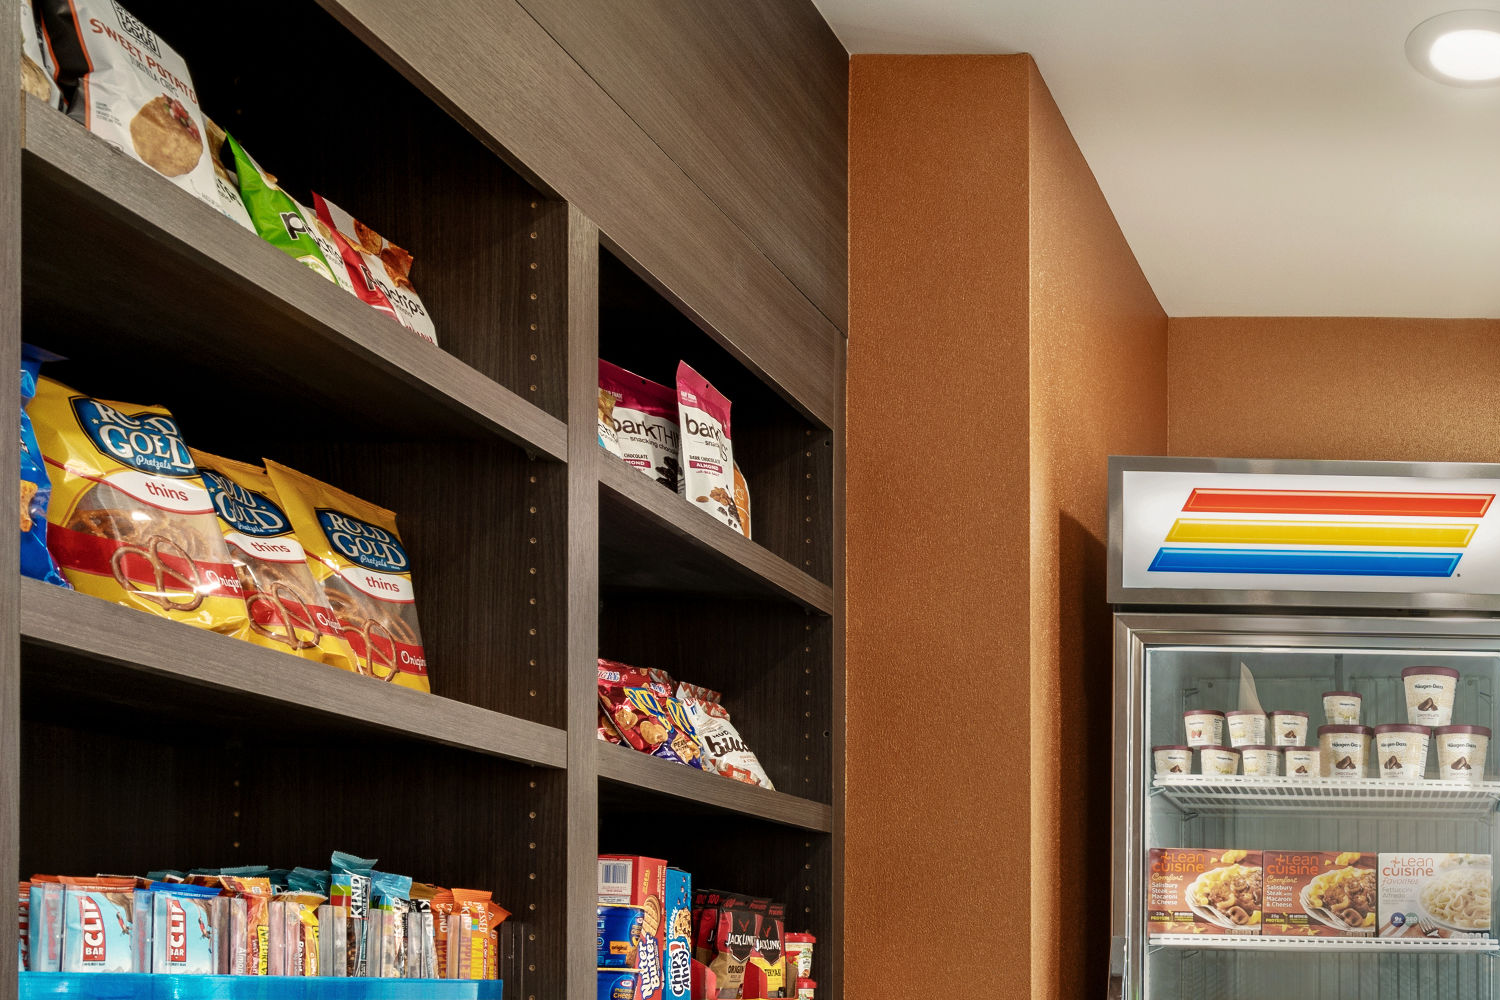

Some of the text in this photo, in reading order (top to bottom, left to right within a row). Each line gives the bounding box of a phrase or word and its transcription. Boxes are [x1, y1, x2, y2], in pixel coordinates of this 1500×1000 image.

[90, 18, 198, 105] SWEET POTATO
[100, 423, 195, 468] GOLD
[696, 462, 719, 471] ALMOND
[144, 480, 189, 502] thins
[216, 489, 285, 532] GOLD
[330, 517, 389, 544] ROLD
[250, 540, 291, 554] thins
[336, 534, 409, 569] GOLD
[365, 575, 401, 594] thins
[1172, 852, 1205, 863] Lean
[1286, 854, 1319, 865] Lean
[1402, 857, 1434, 867] Lean
[1151, 872, 1184, 882] Comfort
[1266, 875, 1298, 885] Comfort
[350, 876, 362, 918] KIND
[81, 895, 105, 947] CLIF
[726, 933, 742, 947] JACK
[84, 946, 105, 957] BAR
[646, 934, 661, 989] Butter
[639, 941, 654, 1000] Nutter
[672, 951, 684, 997] Chips
